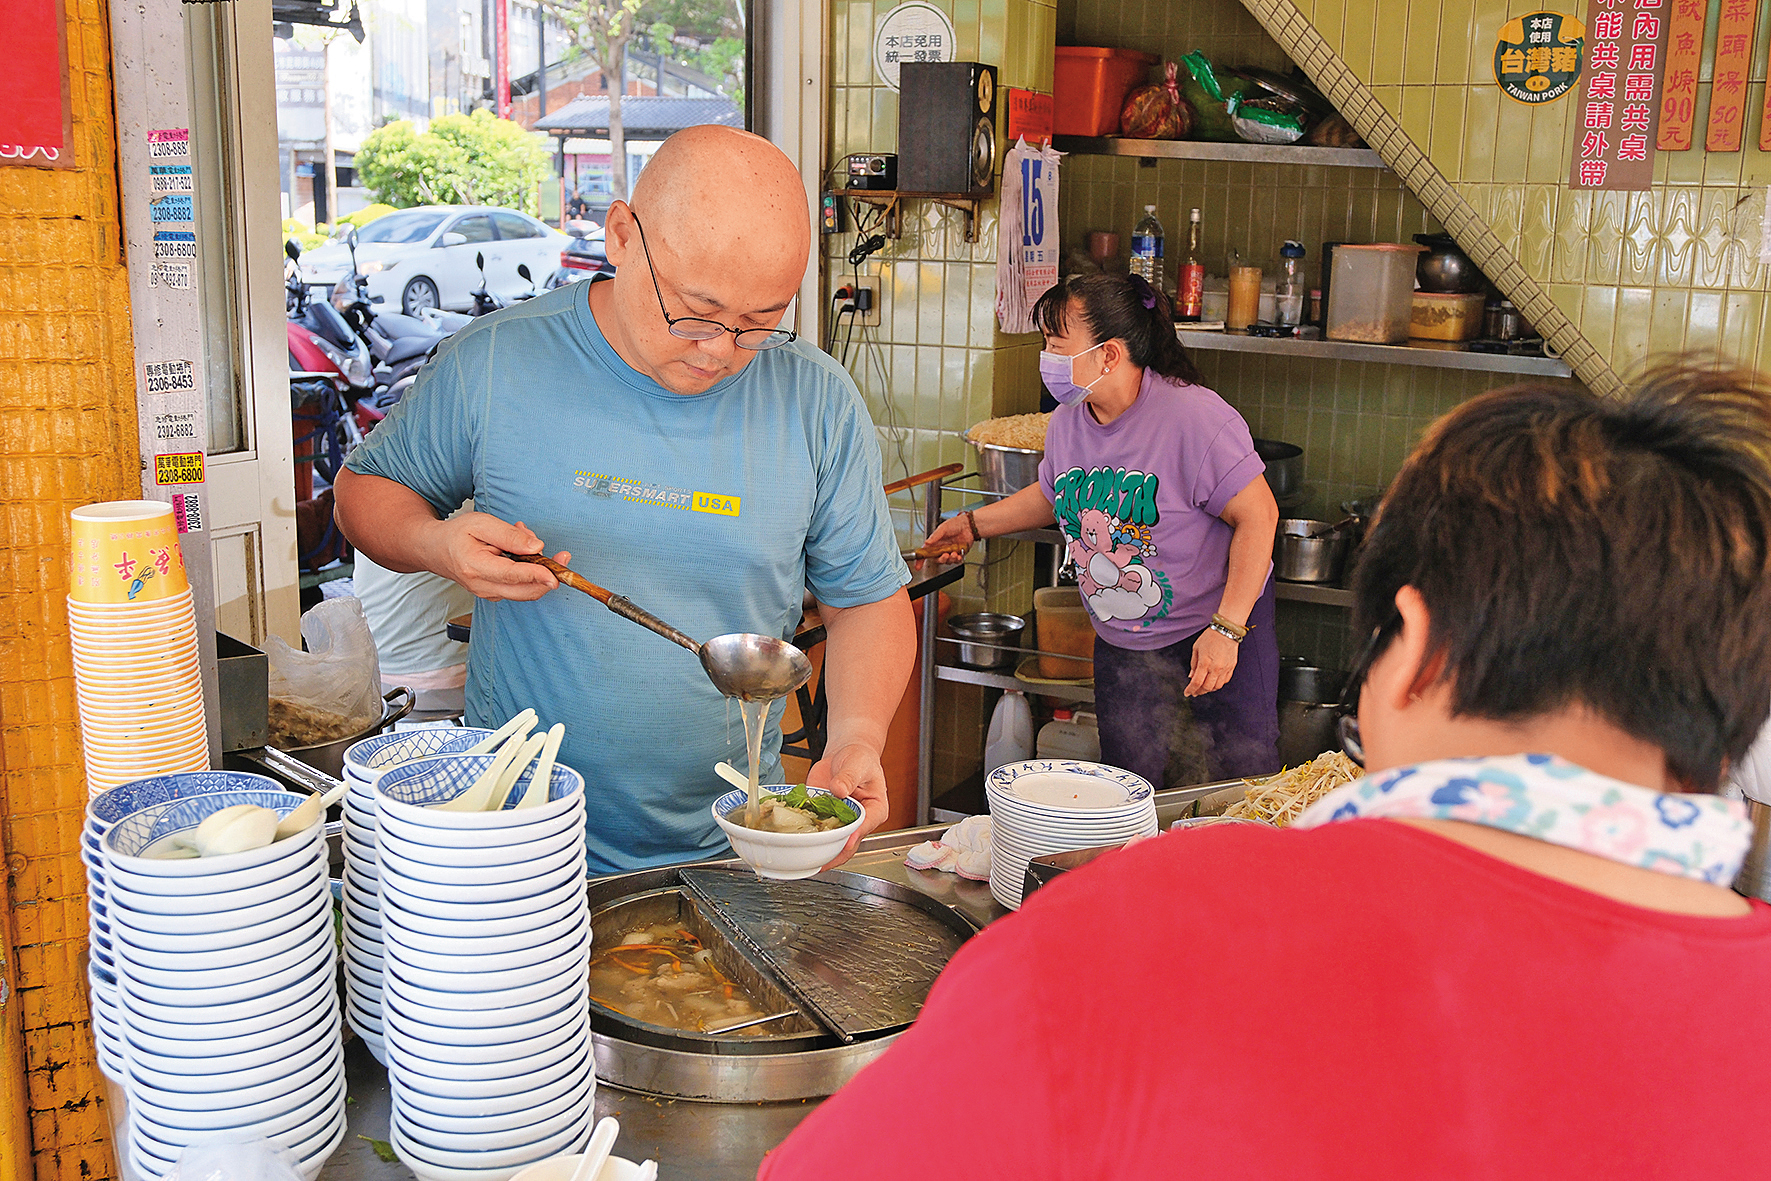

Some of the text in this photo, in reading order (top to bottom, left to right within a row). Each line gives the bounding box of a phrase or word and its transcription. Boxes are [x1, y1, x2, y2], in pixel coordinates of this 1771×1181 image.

[1530, 17, 1553, 30] 本店
[885, 35, 942, 48] 本店免用
[1529, 31, 1551, 43] 使用
[885, 50, 942, 62] 統一發票
[1501, 46, 1577, 74] 台灣豬
[1507, 82, 1568, 101] TAIWAN PORK
[1021, 158, 1044, 246] 15
[155, 243, 196, 257] 2308-6800
[148, 374, 193, 392] 2306-8453
[158, 468, 203, 483] 2308-6800
[573, 476, 691, 504] SUPERSMART
[698, 496, 734, 511] USA
